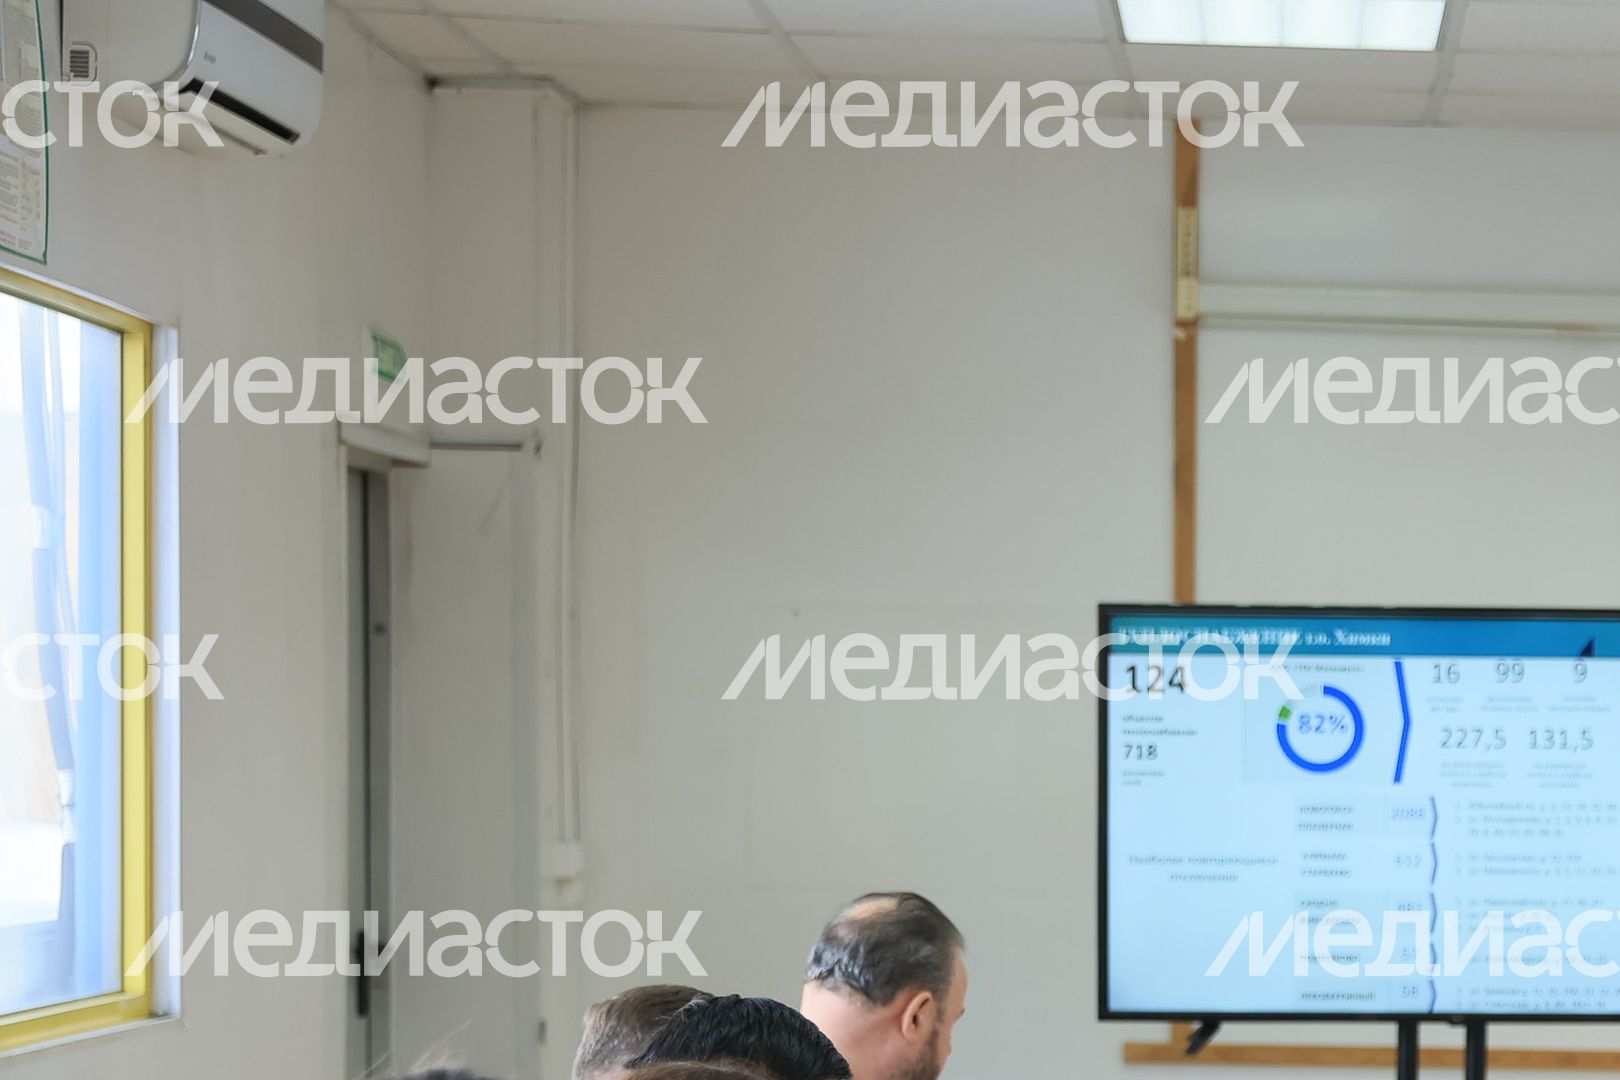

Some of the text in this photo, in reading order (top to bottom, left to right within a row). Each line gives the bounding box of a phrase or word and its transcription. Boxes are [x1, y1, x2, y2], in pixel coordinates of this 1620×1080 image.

[1124, 664, 1189, 694] 124
[1432, 662, 1461, 684] 16
[1494, 661, 1526, 684] 99
[1572, 661, 1588, 684] 9
[1298, 714, 1349, 735] 82%
[1122, 743, 1159, 761] 718
[1439, 728, 1508, 754] 227,5
[1527, 728, 1595, 754] 131,5
